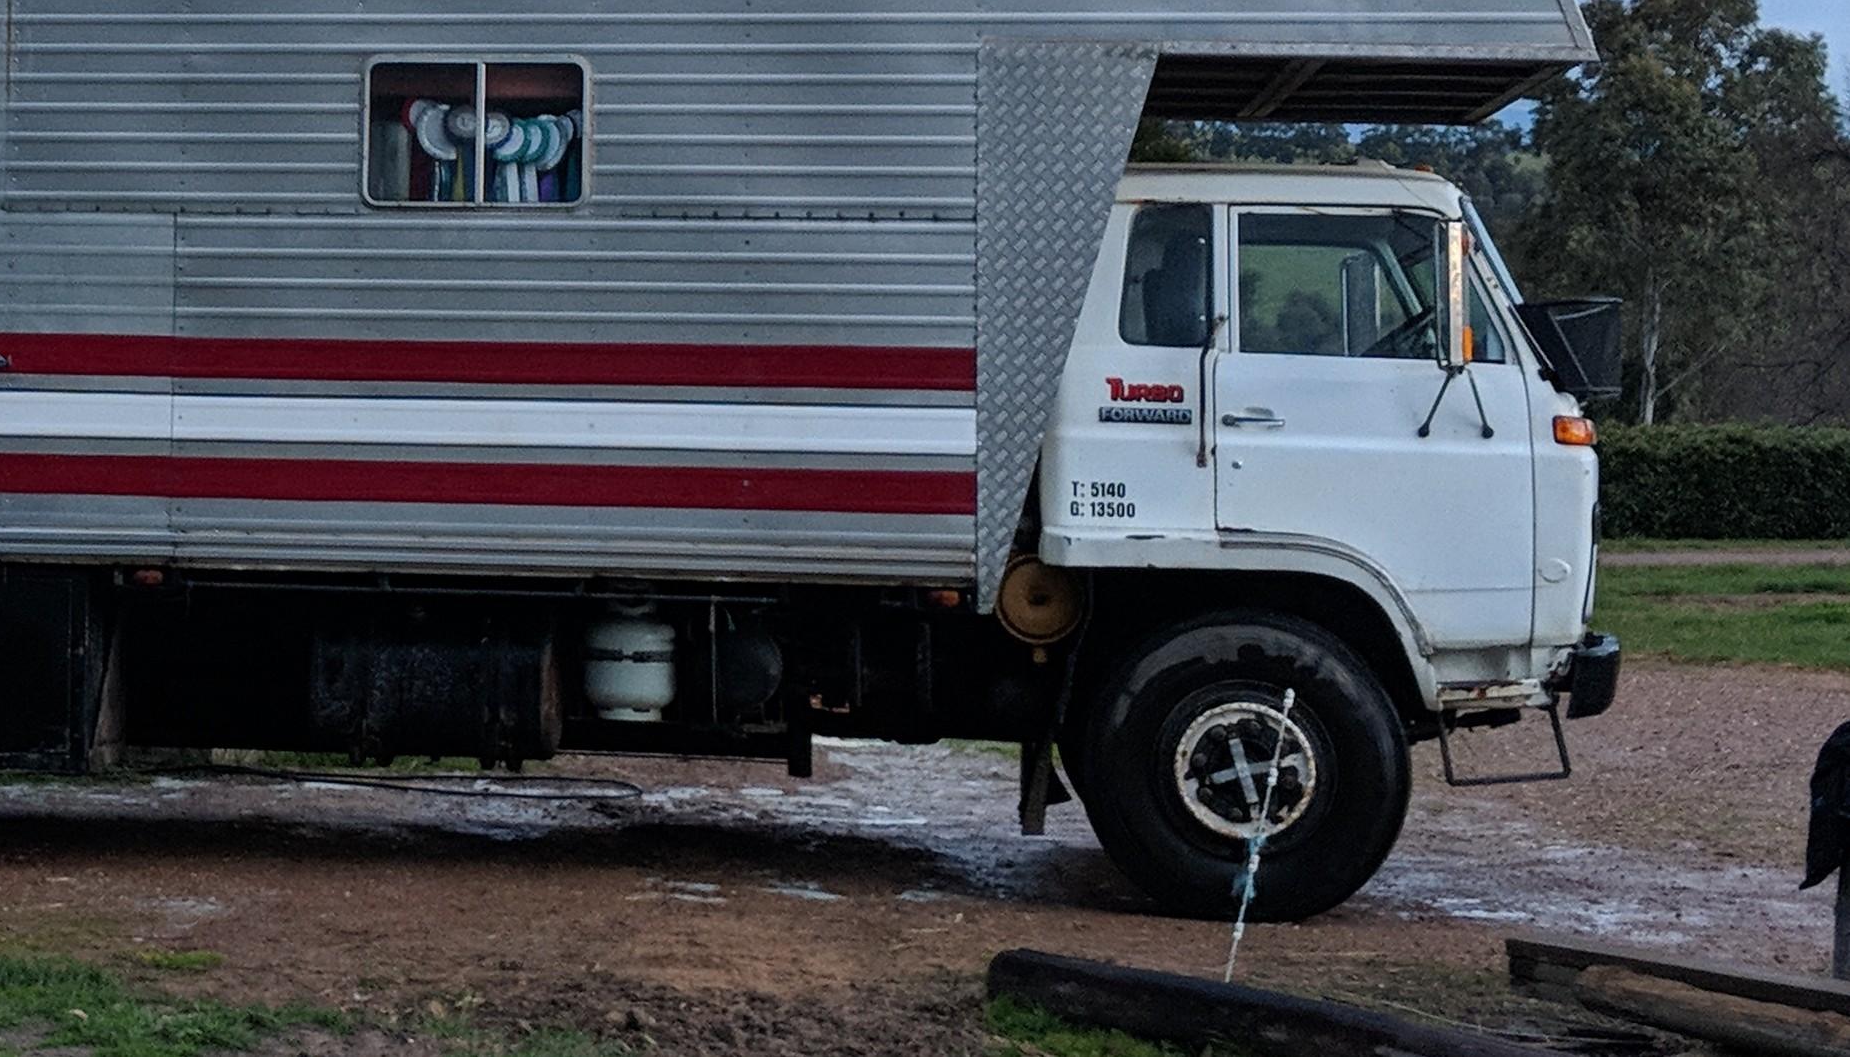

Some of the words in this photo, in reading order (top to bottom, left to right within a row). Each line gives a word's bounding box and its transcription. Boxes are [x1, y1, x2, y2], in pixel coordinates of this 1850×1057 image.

[1101, 408, 1191, 423] FORWARD
[1071, 480, 1085, 498] T:
[1090, 482, 1126, 498] 5140
[1069, 501, 1085, 517] G:
[1090, 502, 1136, 518] 13500
